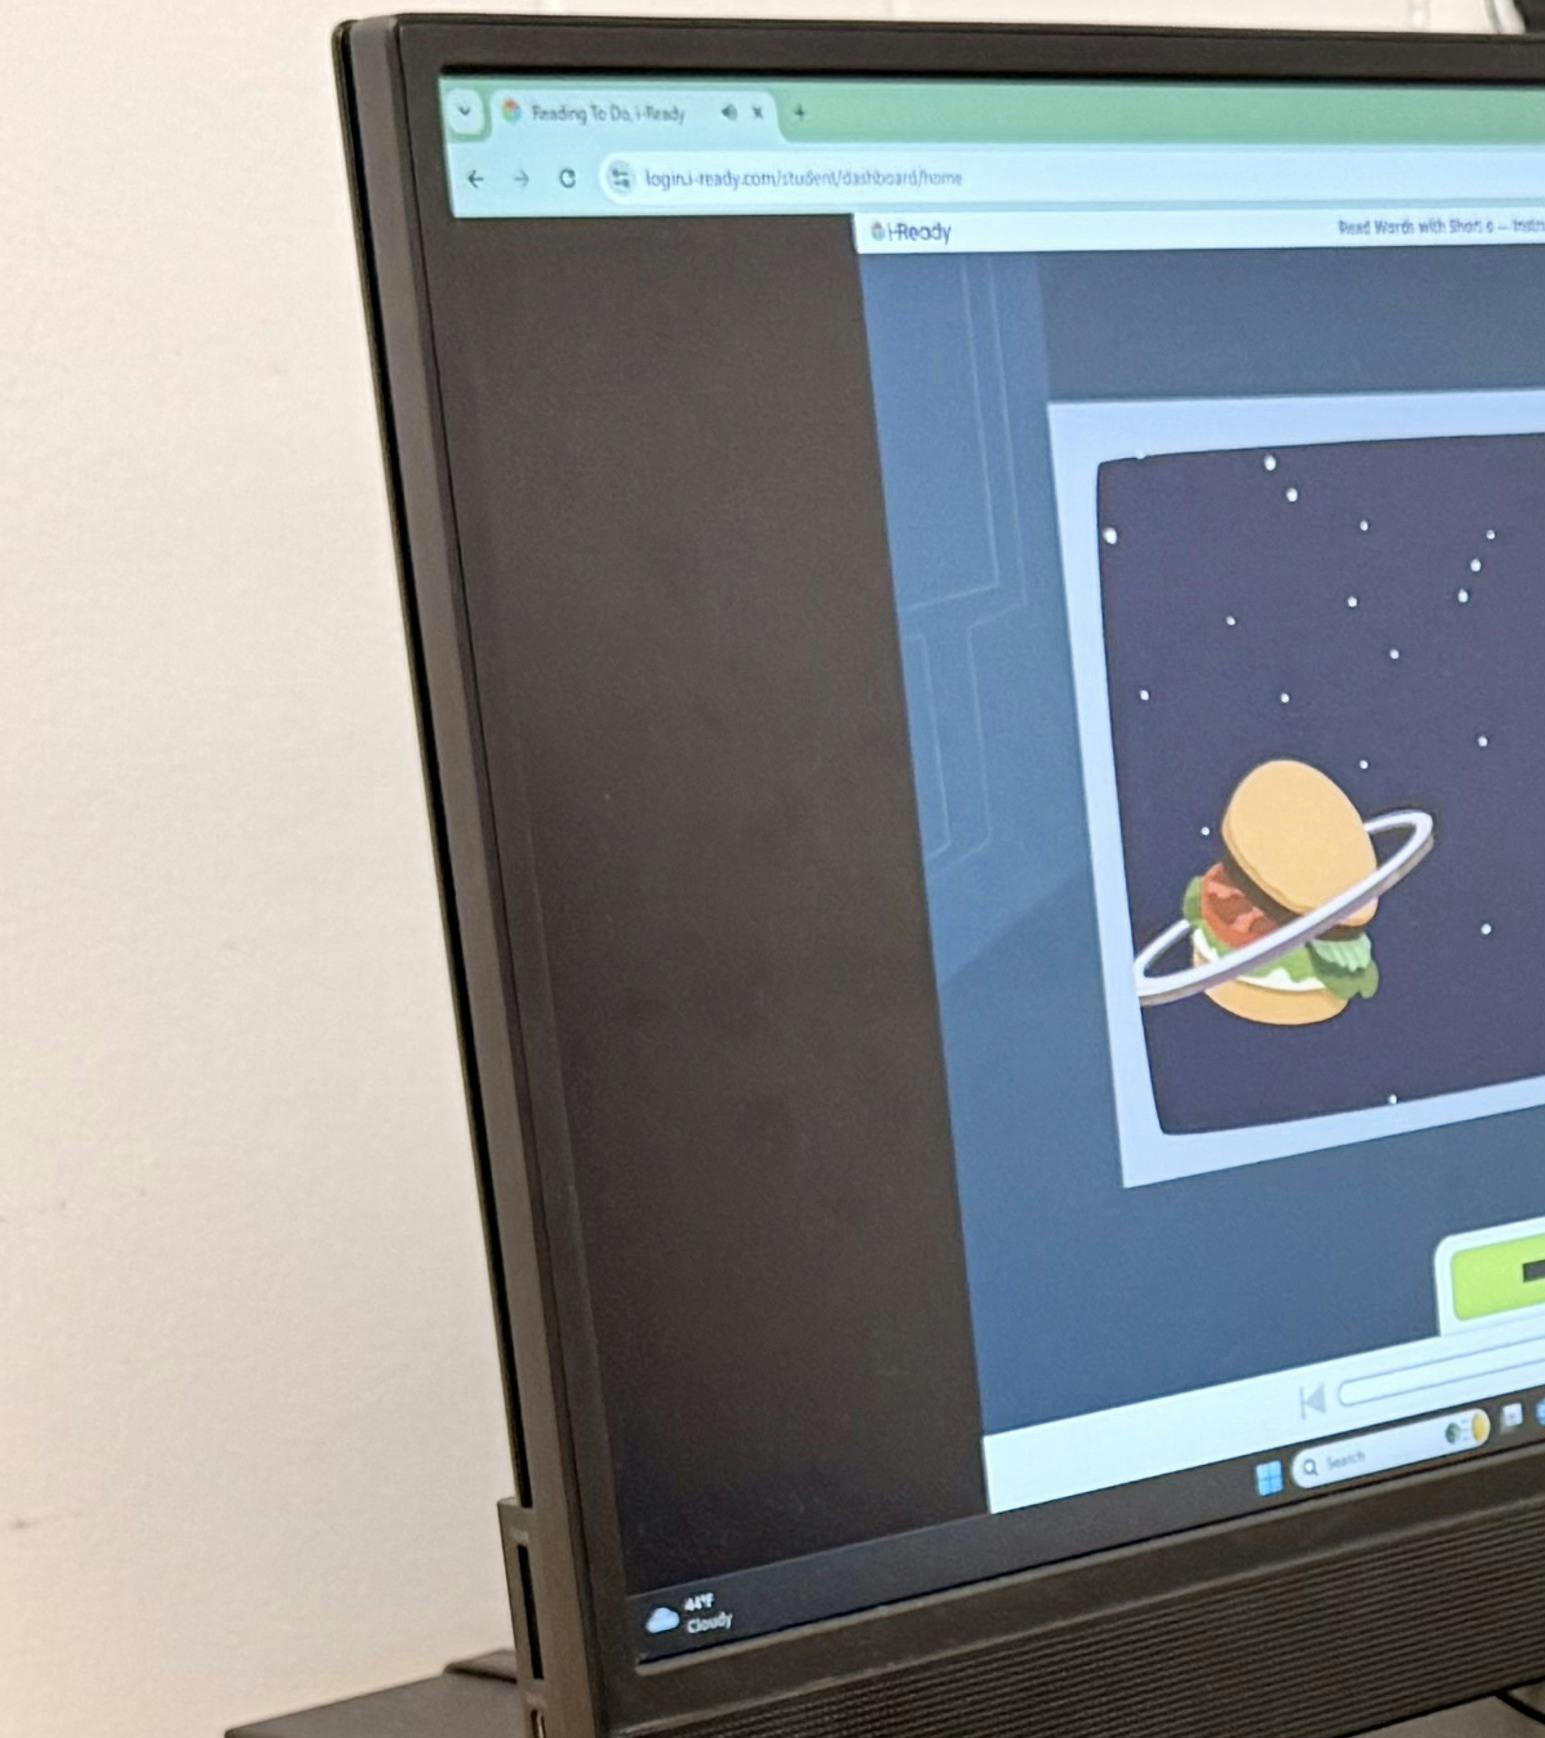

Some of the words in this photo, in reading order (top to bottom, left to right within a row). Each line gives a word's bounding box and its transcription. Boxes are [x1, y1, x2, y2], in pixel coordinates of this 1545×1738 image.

[532, 104, 588, 125] Reading
[591, 104, 607, 121] To
[1418, 217, 1447, 234] with
[686, 1610, 734, 1634] Cloudy
